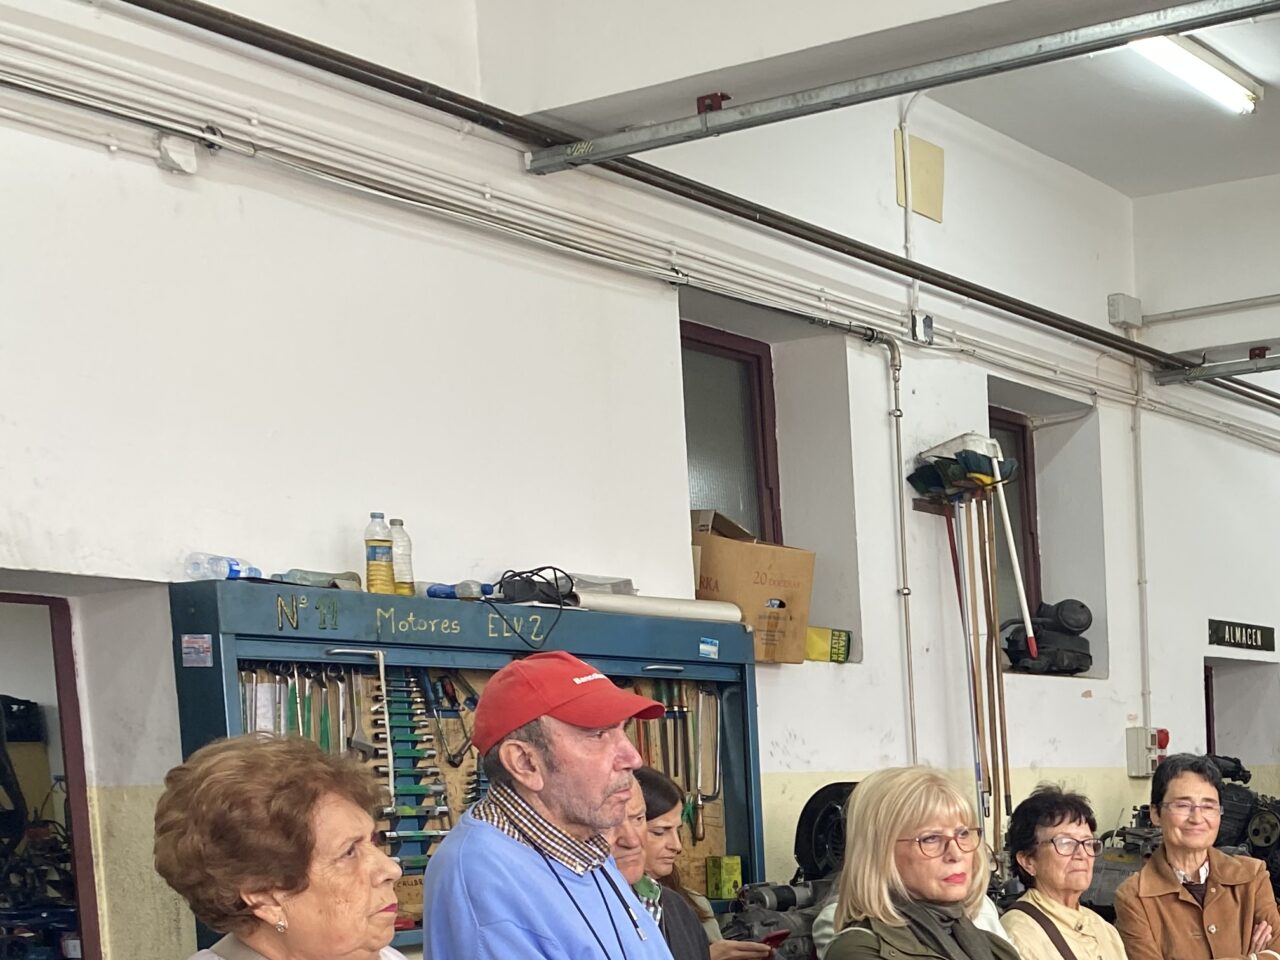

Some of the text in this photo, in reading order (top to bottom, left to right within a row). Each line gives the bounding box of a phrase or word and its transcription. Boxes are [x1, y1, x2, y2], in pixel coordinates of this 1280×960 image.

[753, 571, 767, 585] 20
[376, 607, 461, 634] Motores
[838, 632, 847, 662] MANN
[1224, 625, 1262, 646] ALMACEN
